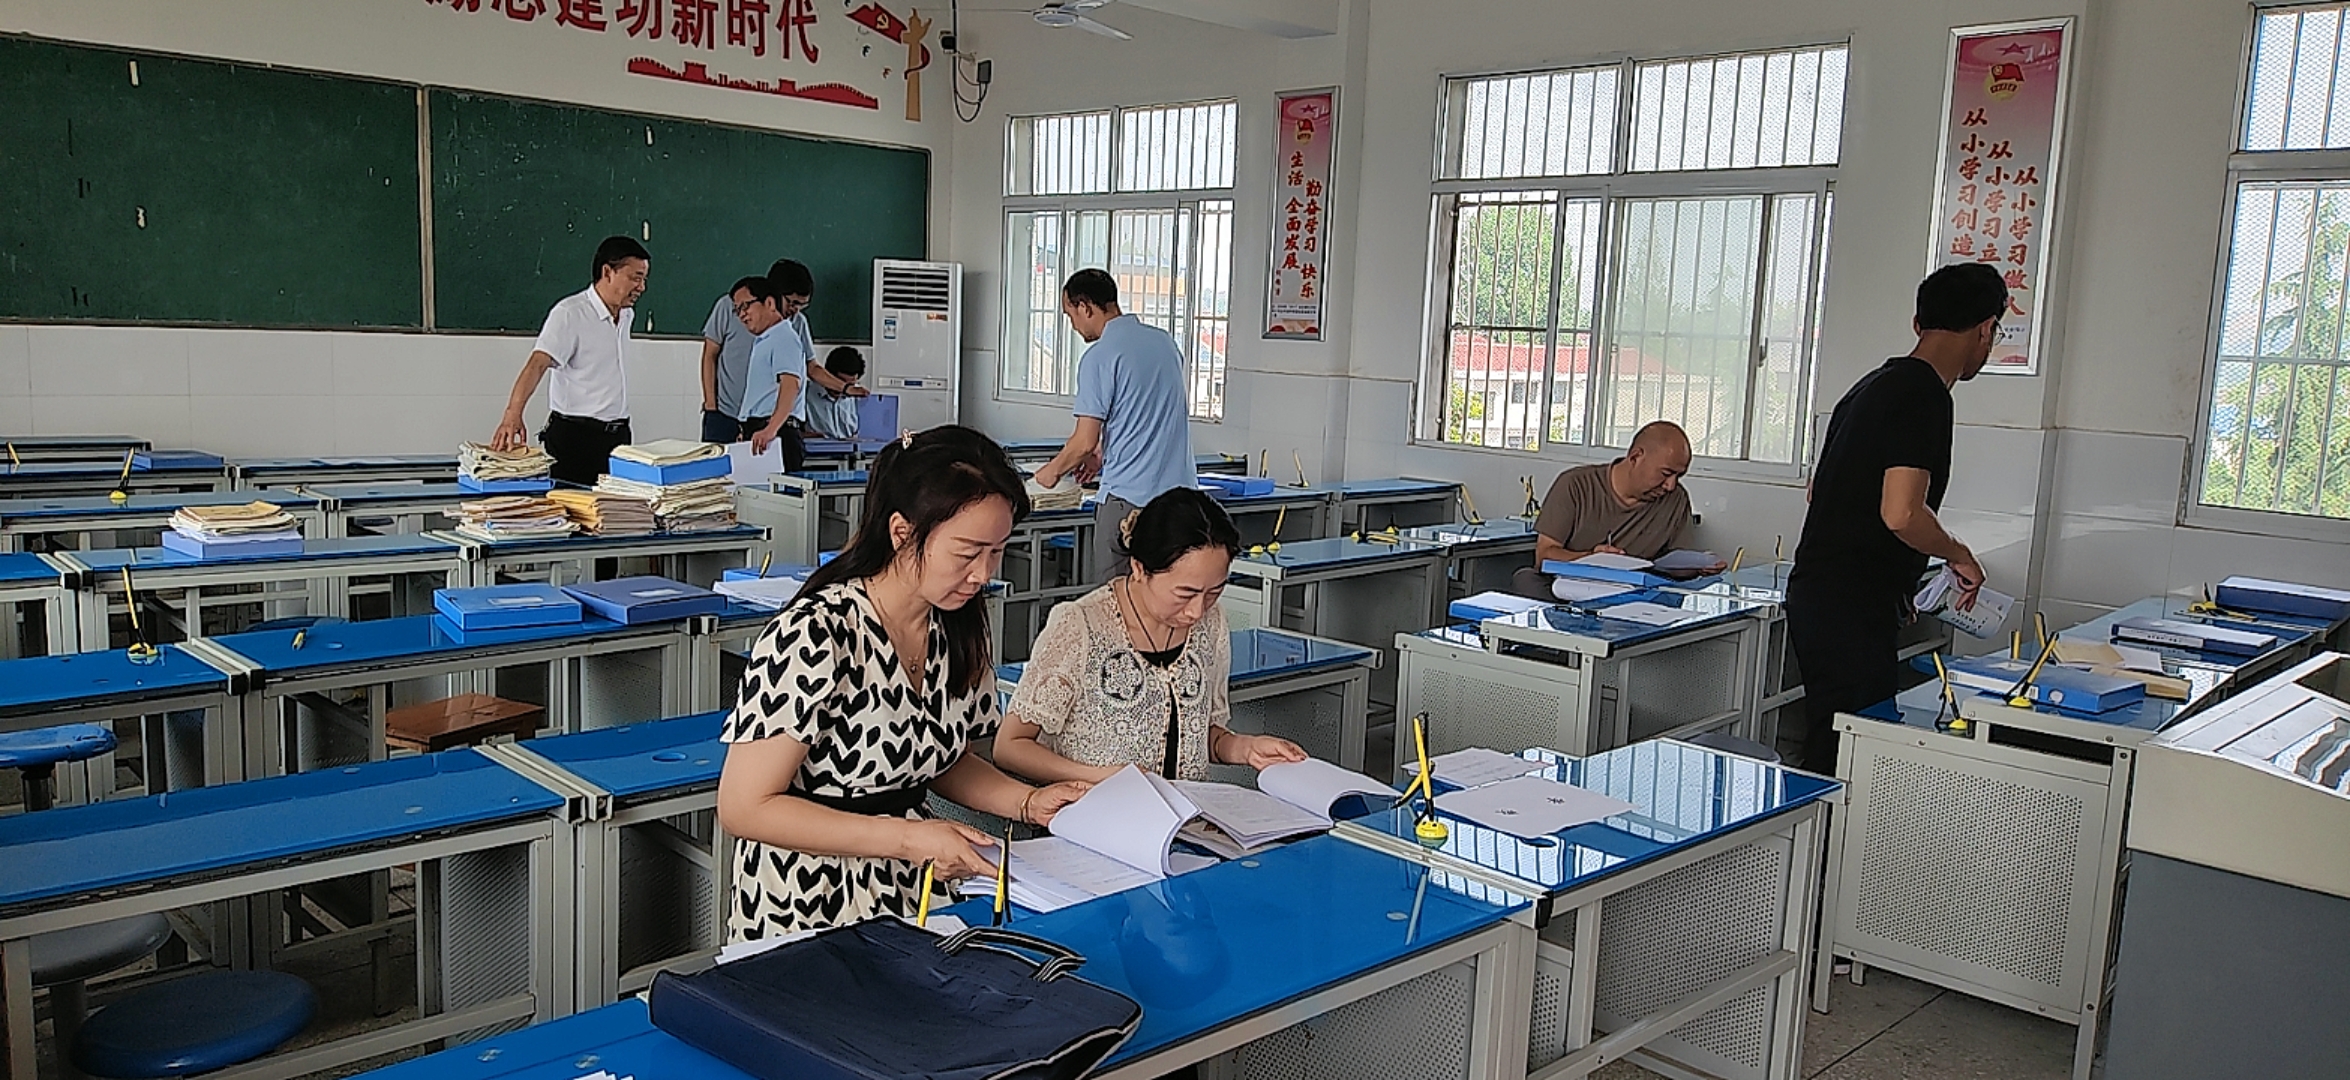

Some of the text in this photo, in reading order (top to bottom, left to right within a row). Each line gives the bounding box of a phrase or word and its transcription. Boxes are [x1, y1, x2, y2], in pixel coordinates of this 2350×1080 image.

[1287, 150, 1304, 187] 生活
[1950, 107, 1988, 256] 从小学习创造
[1281, 196, 1304, 270] 全面发展
[1300, 178, 1323, 299] 勤奋学习 快乐
